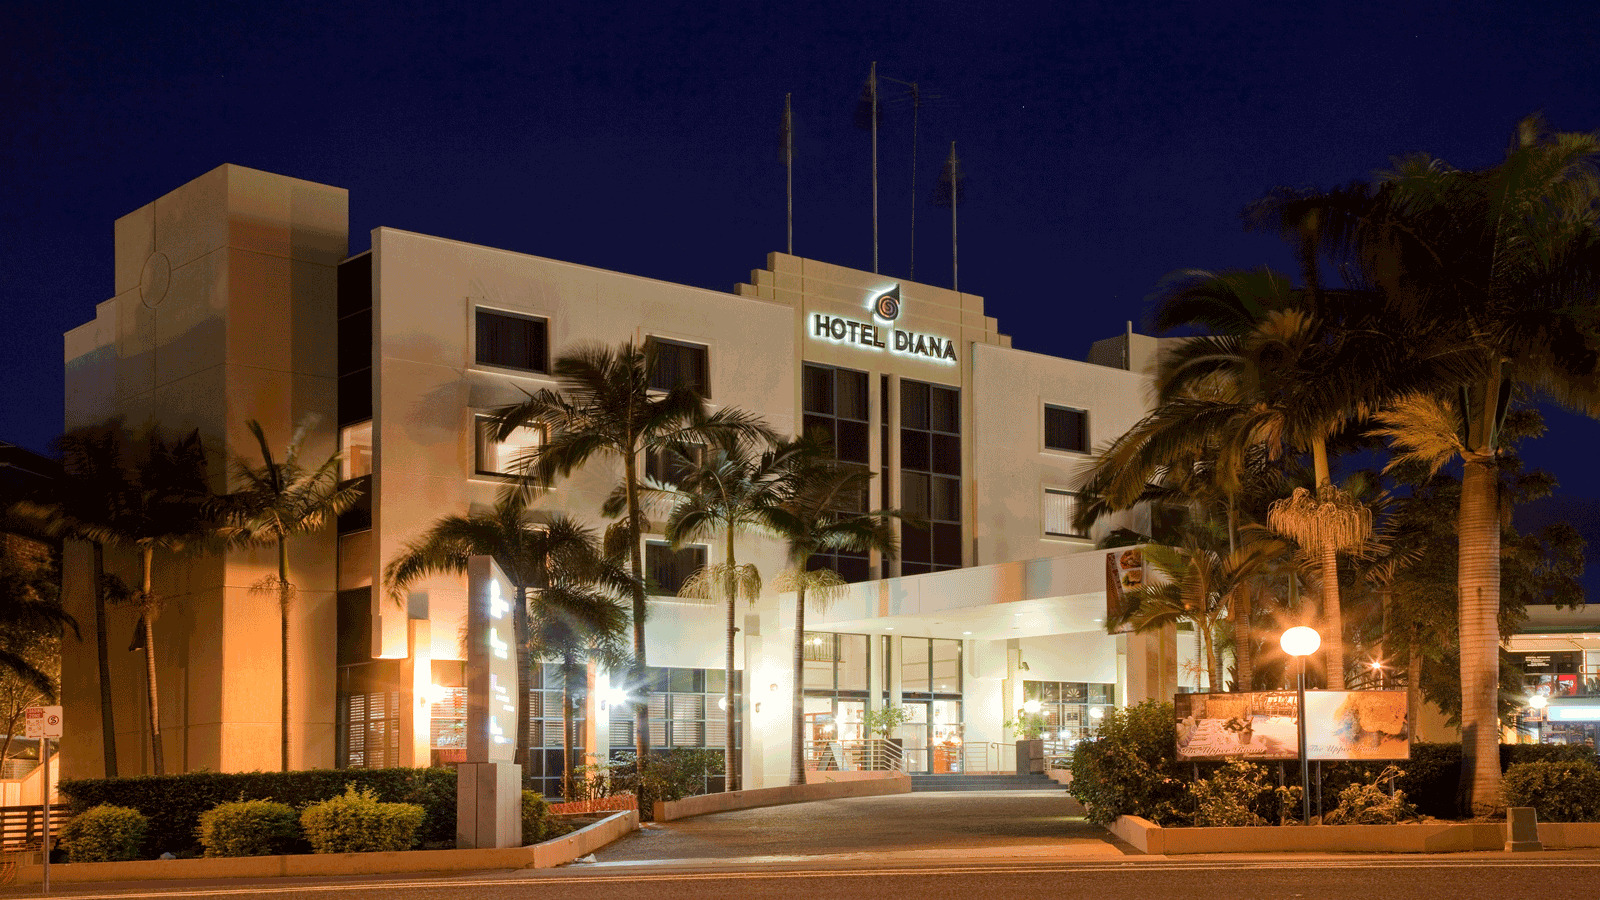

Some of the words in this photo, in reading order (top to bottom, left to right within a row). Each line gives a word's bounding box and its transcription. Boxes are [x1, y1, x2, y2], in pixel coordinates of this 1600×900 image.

[814, 314, 885, 348] HOTEL
[895, 330, 957, 361] DIANA
[1181, 746, 1198, 754] The
[1201, 746, 1231, 756] Upper
[1308, 744, 1323, 752] The
[1326, 744, 1352, 755] Upper
